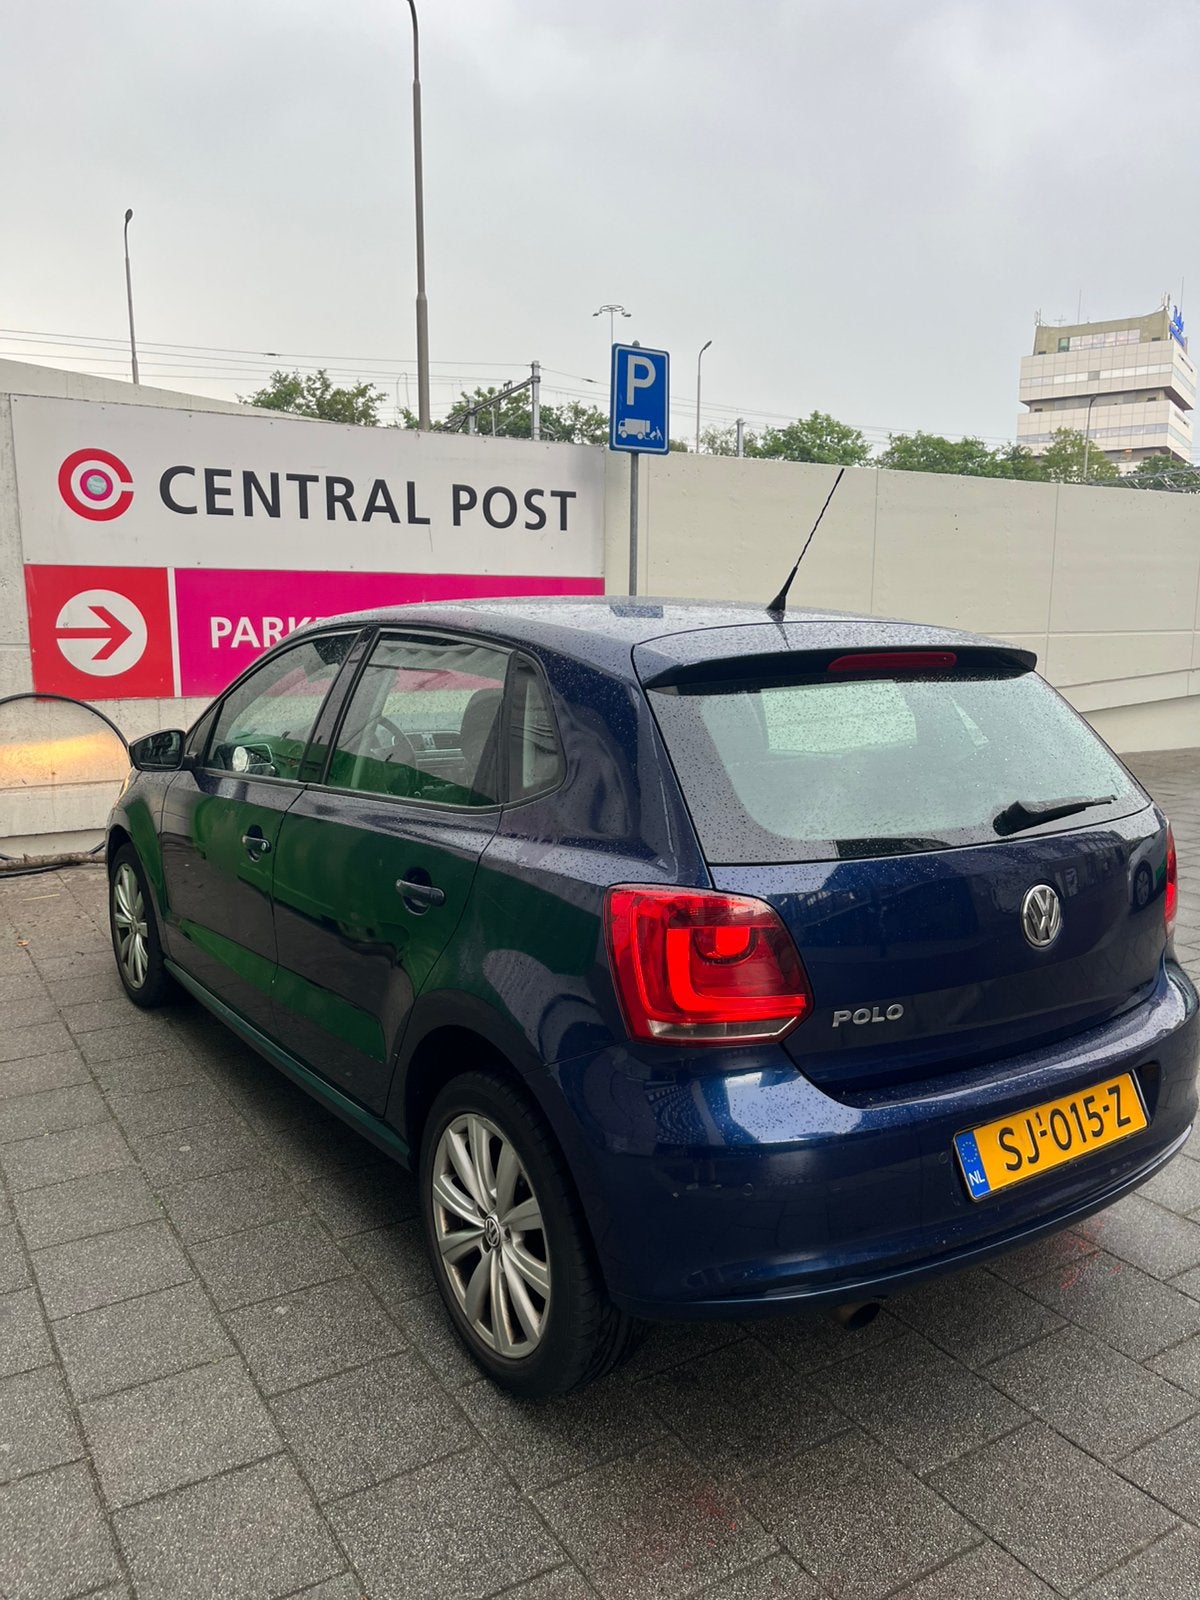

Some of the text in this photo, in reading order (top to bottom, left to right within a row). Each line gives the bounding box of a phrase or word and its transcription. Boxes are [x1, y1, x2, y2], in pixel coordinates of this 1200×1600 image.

[626, 354, 656, 406] P
[159, 465, 577, 532] CENTRAL POST
[210, 616, 326, 648] PARK
[832, 1004, 904, 1028] POLO
[968, 1169, 985, 1186] NL
